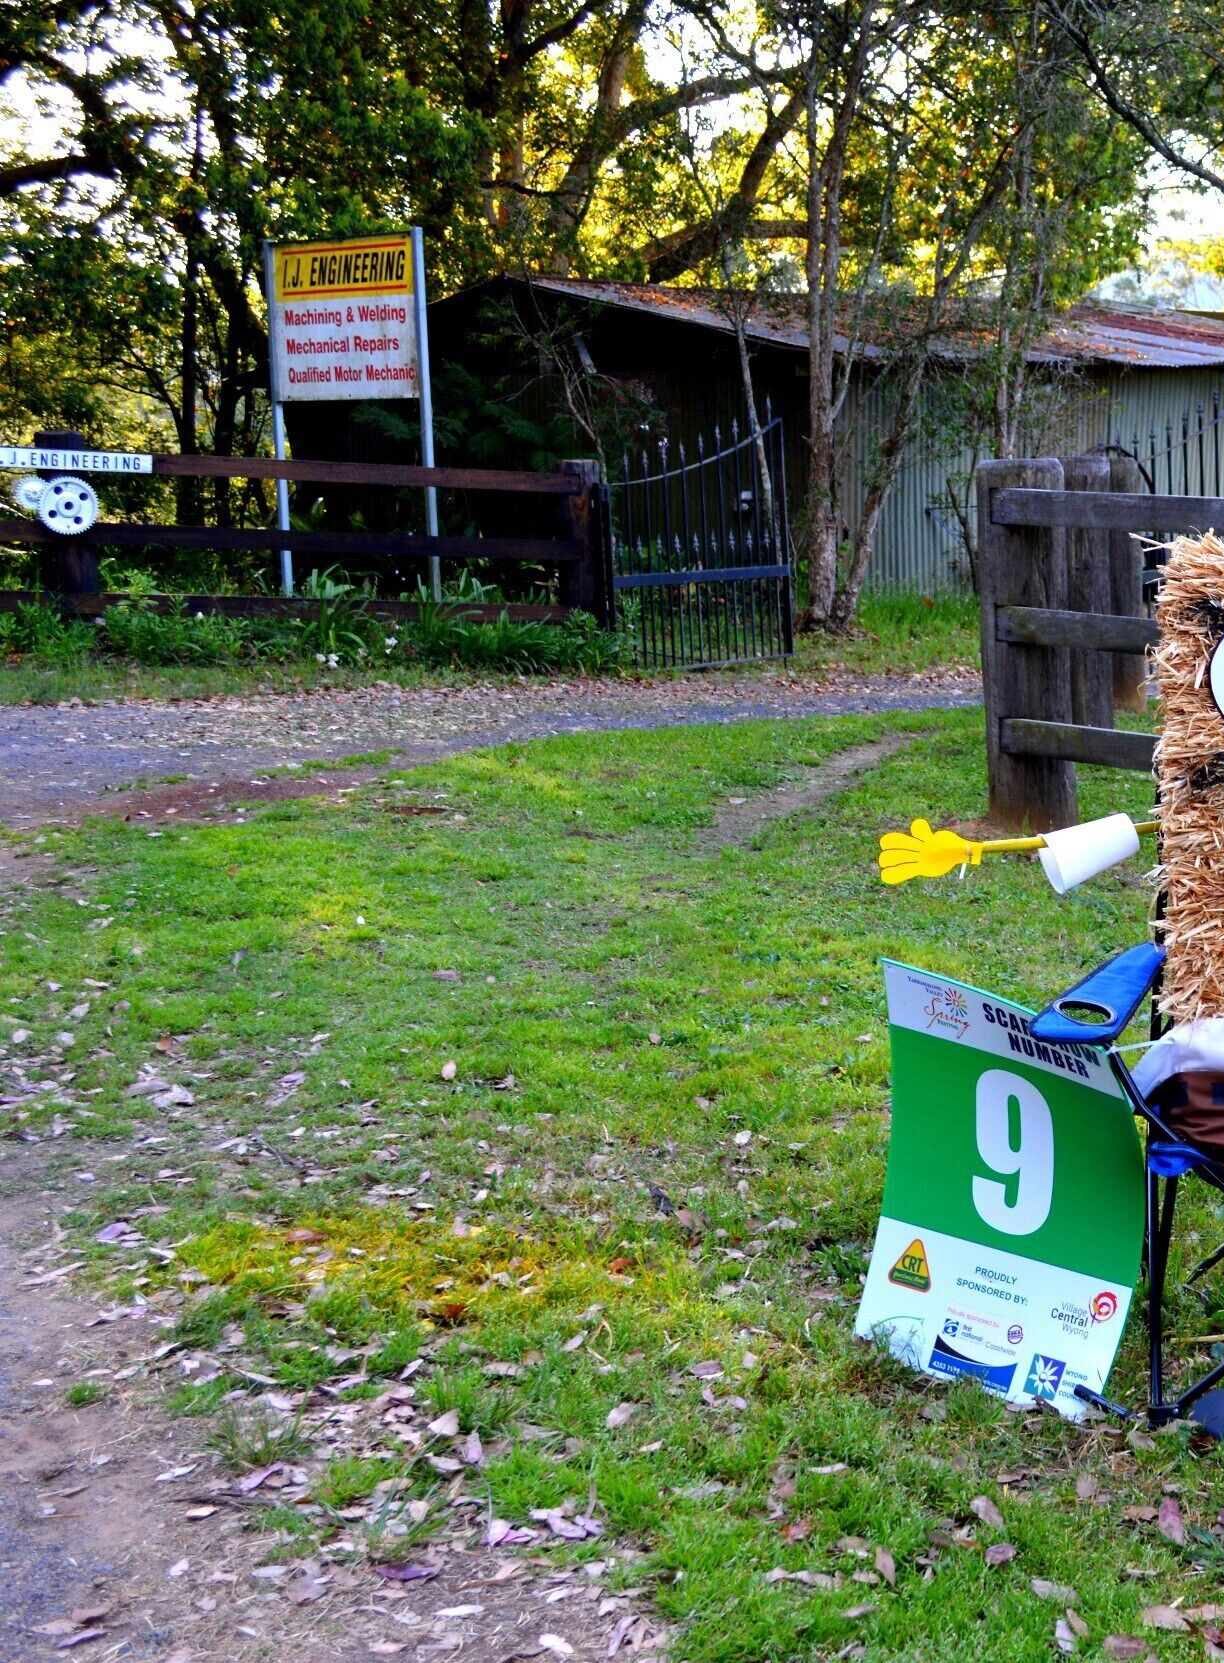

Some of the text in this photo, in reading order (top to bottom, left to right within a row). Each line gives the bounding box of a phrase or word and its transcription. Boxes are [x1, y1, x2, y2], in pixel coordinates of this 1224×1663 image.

[283, 250, 406, 288] I.J. ENGINEERING
[285, 304, 406, 327] Machining & Welding
[287, 334, 399, 355] Mechanical Repairs
[289, 363, 415, 384] Qualified Motor Mechanic
[924, 997, 970, 1039] Spring
[1008, 1032, 1090, 1078] NUMBER
[972, 1069, 1055, 1236] 9
[902, 1254, 924, 1273] CRT
[975, 1266, 1018, 1285] PROUDLY
[957, 1277, 1028, 1306] SPONSORED BY:
[1051, 1308, 1088, 1327] Central
[1062, 1301, 1088, 1316] Village
[961, 1331, 983, 1342] national
[1062, 1323, 1089, 1339] Wyong
[1061, 1380, 1075, 1388] SHIR
[1065, 1370, 1088, 1381] WYONG
